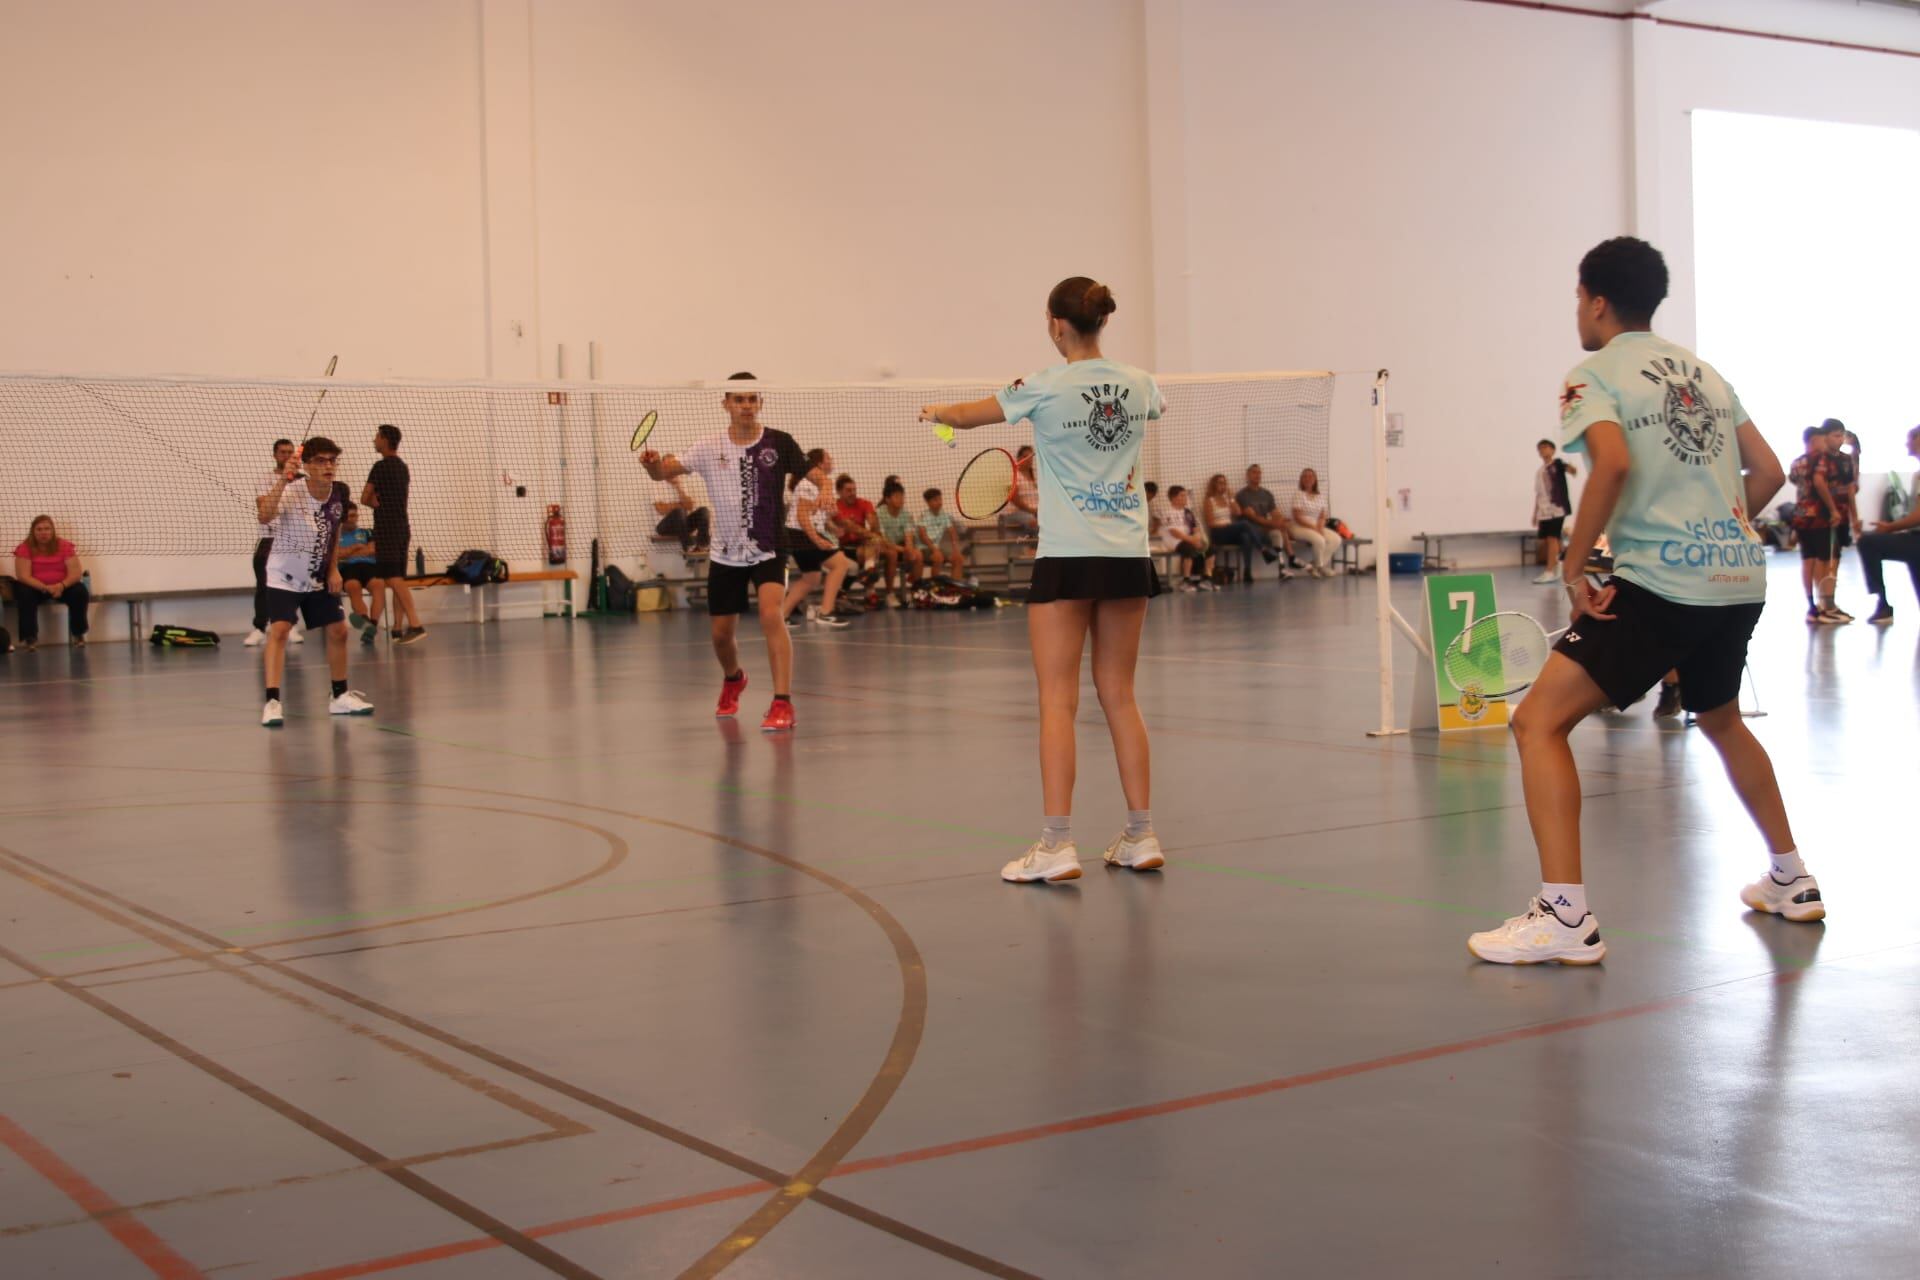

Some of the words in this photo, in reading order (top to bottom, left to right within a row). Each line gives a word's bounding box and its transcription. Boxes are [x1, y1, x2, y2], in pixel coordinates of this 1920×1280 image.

[1641, 357, 1702, 385] AURIA
[1081, 384, 1129, 404] AURIA
[1062, 420, 1087, 429] LANZA
[1627, 413, 1662, 431] LANZA
[1663, 436, 1711, 466] BADMINTO
[740, 454, 753, 529] LANZAROTE
[1090, 480, 1125, 497] Islas
[1448, 591, 1475, 654] 7
